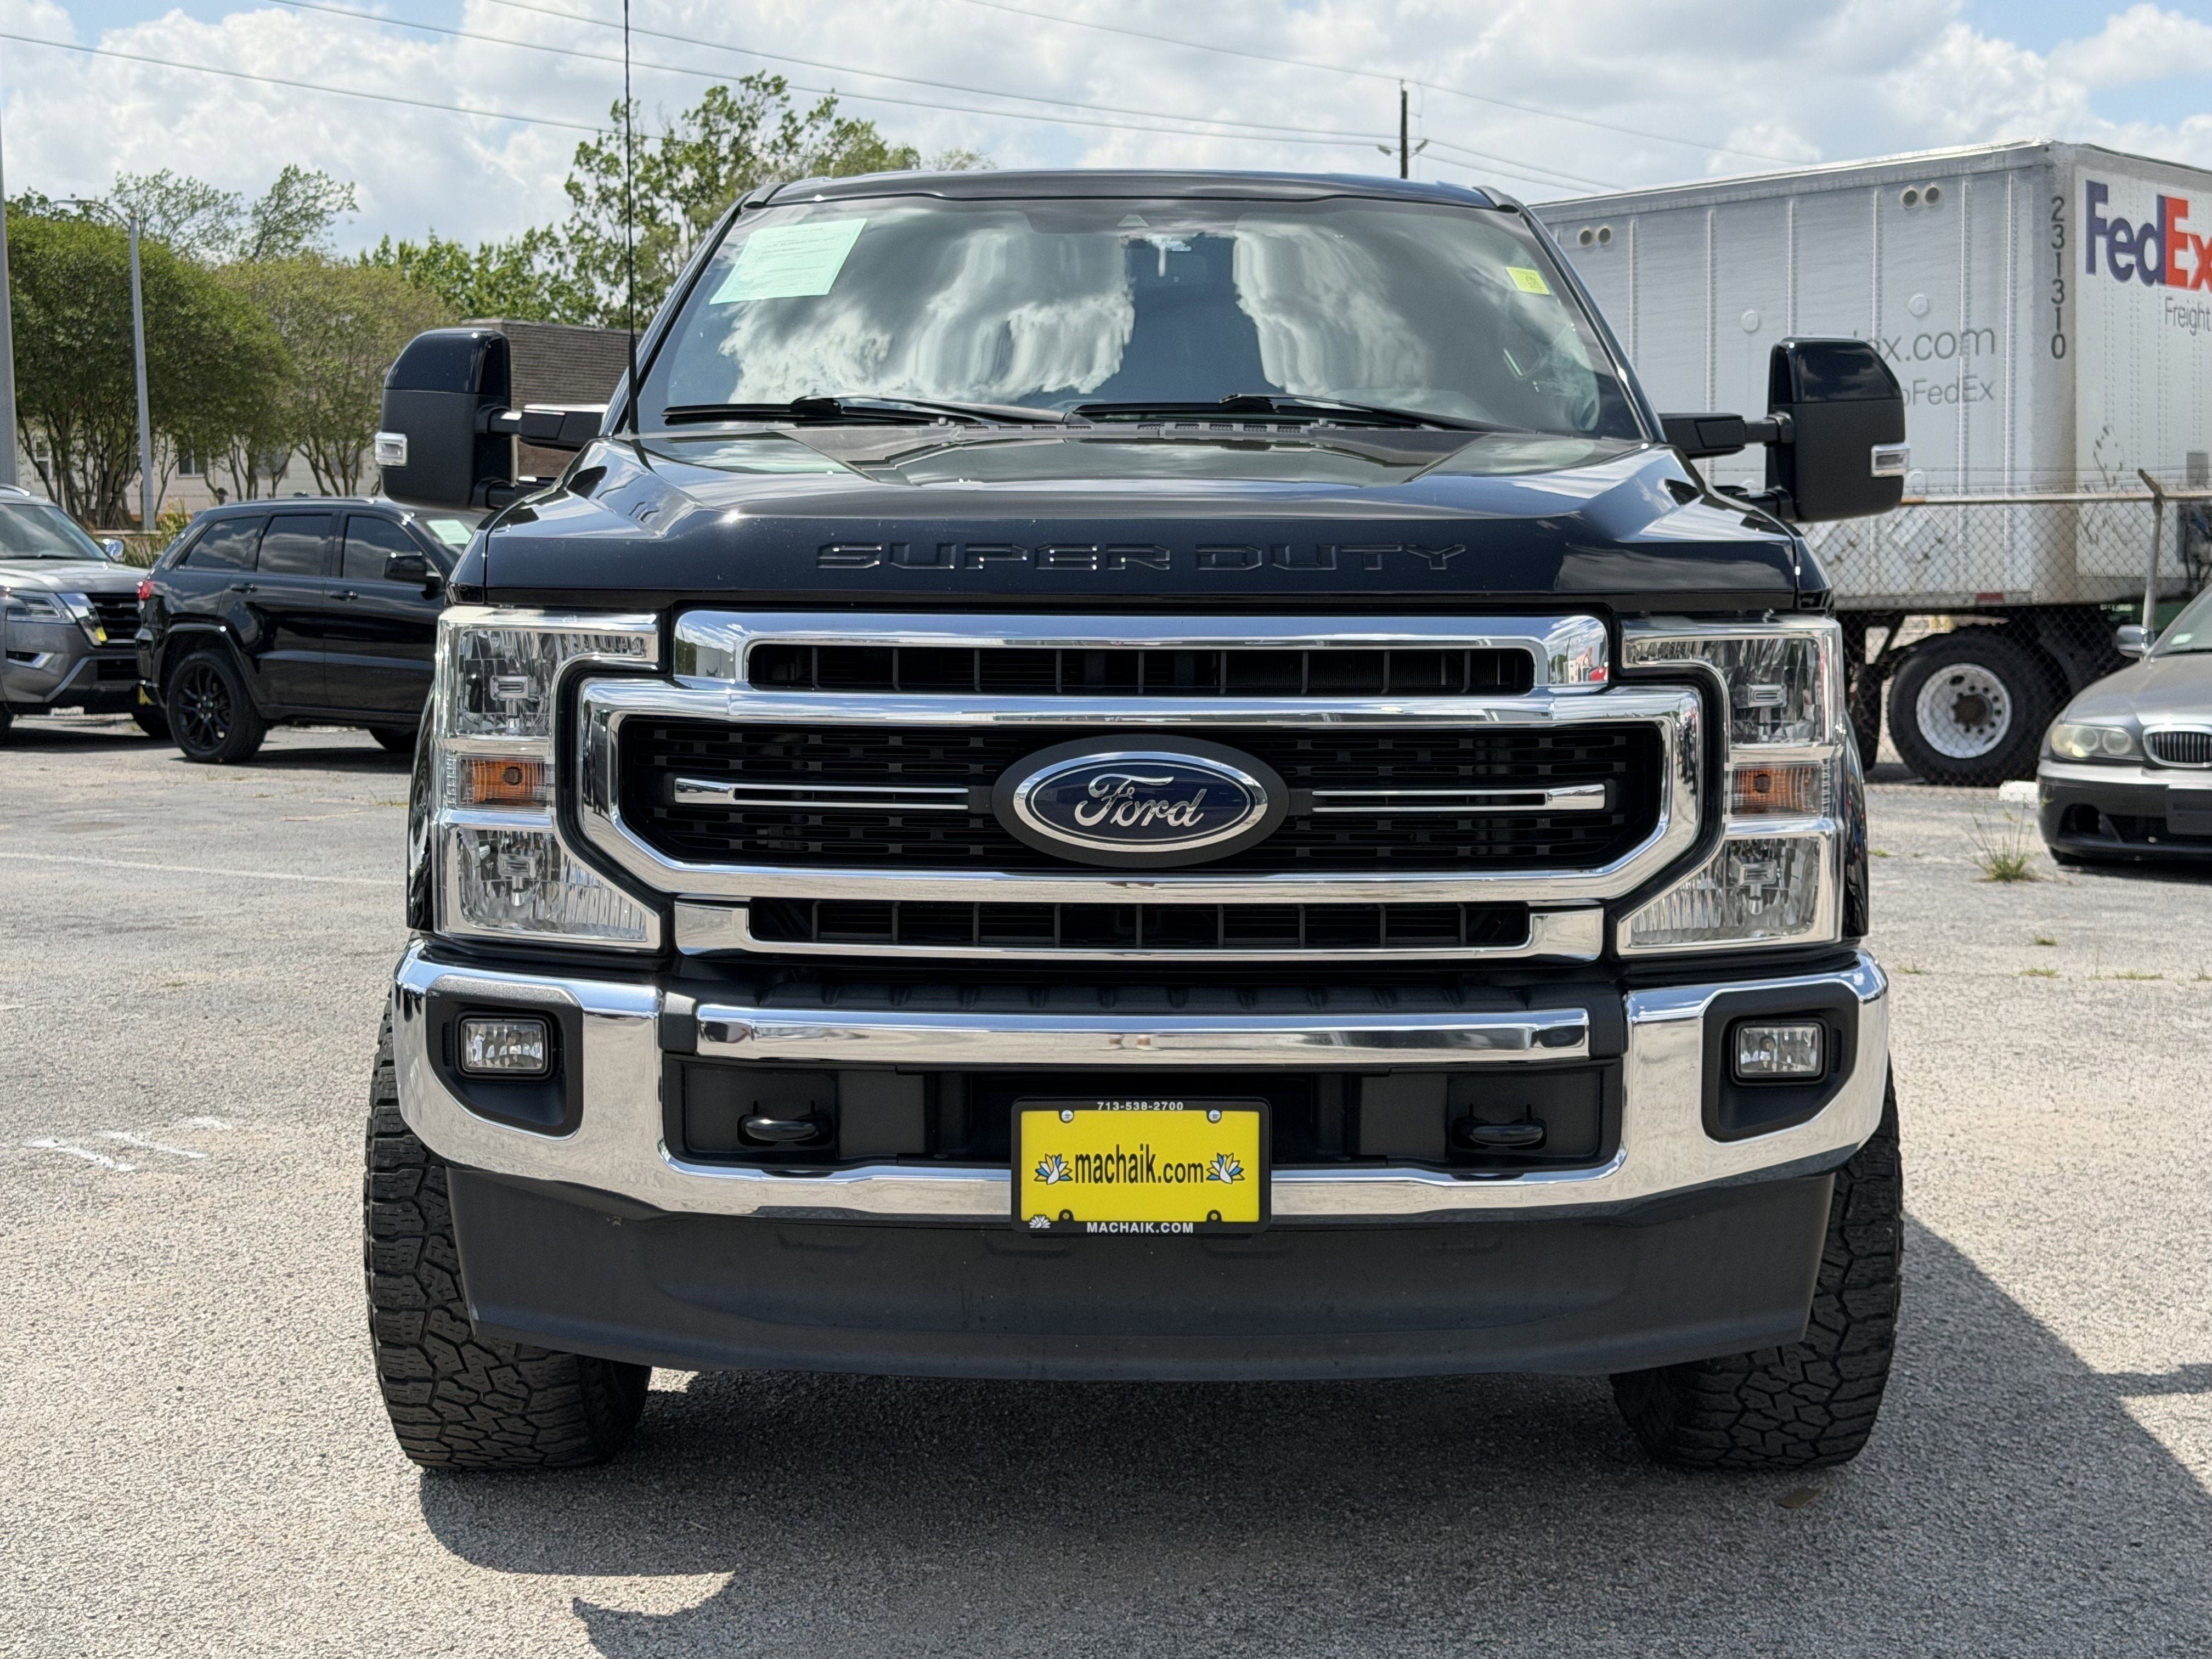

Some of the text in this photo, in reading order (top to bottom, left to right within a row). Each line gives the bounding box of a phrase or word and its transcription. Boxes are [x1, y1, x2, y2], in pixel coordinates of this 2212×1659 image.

[2085, 179, 2212, 294] FedEx
[2051, 196, 2066, 360] 231310
[2165, 296, 2212, 337] Freight
[1853, 327, 1995, 363] x.com
[817, 543, 1466, 571] SUPER DUTY
[1074, 773, 1207, 827] Ford
[1097, 1101, 1184, 1111] 713-538-2700
[1074, 1143, 1204, 1184] machaik.com
[1086, 1222, 1194, 1234] MACHAIK.COM
